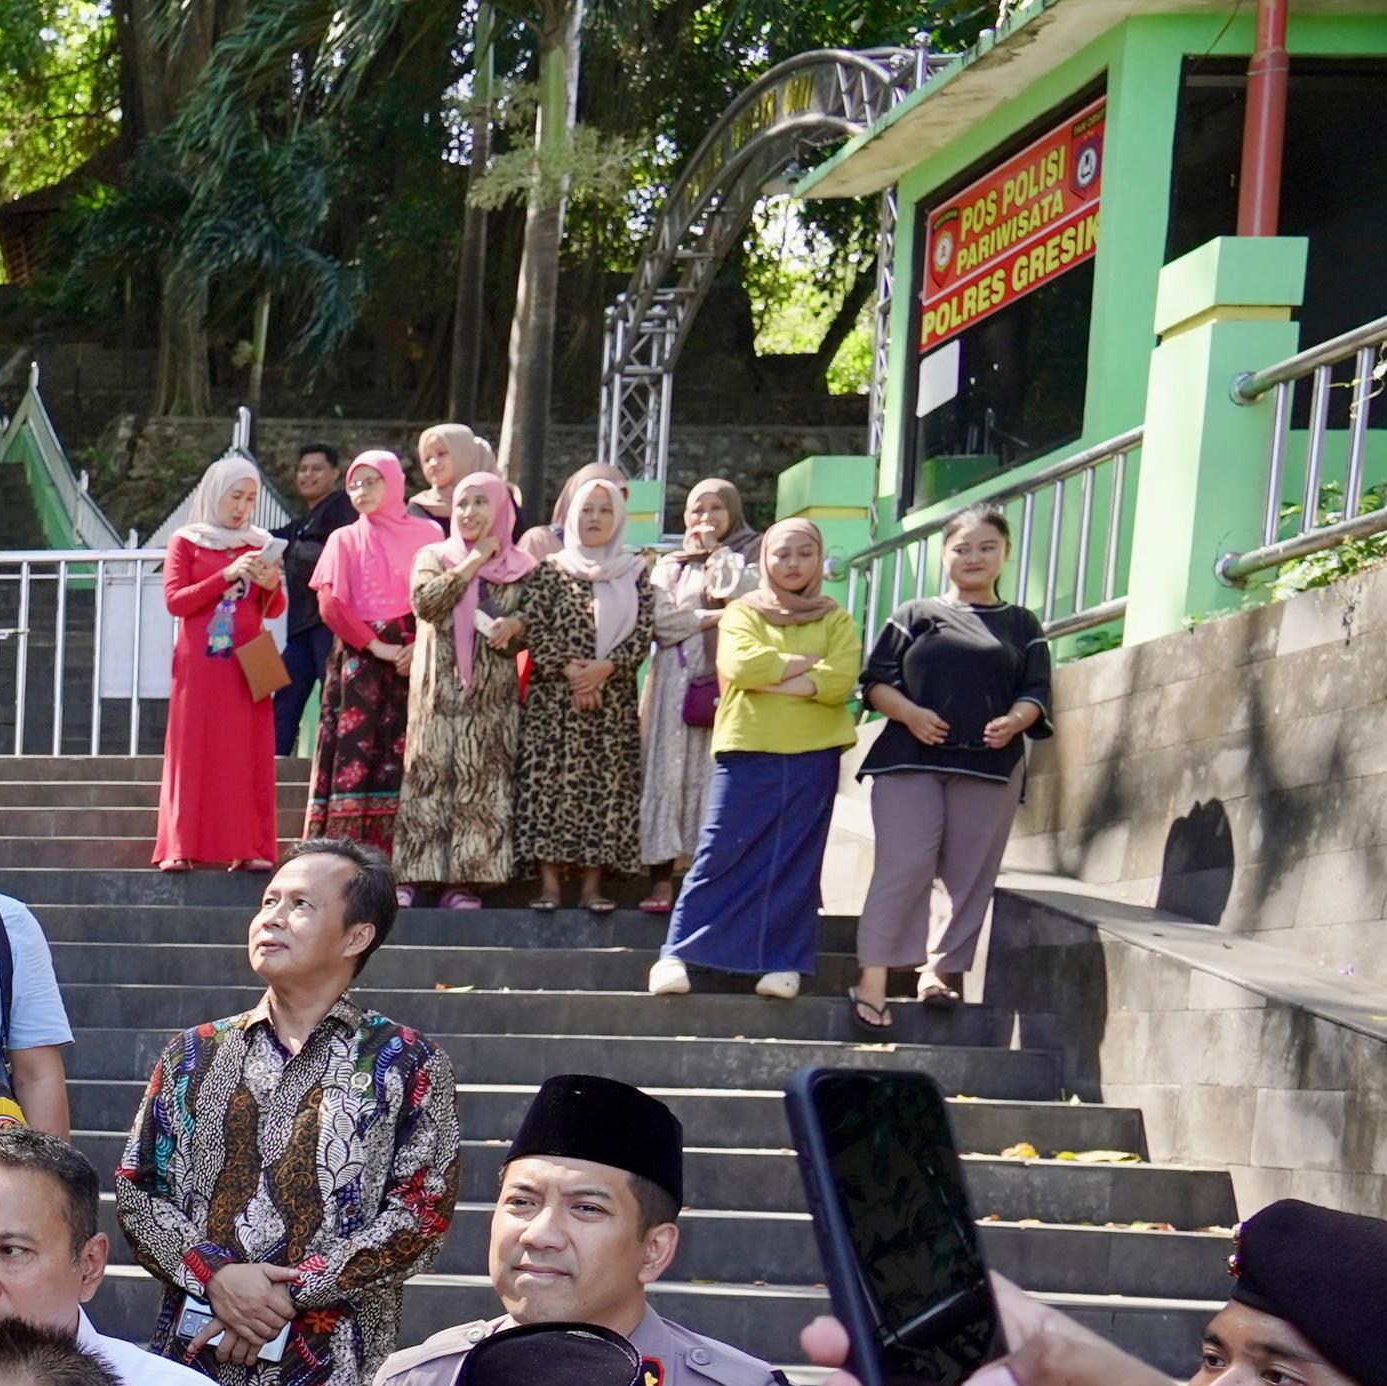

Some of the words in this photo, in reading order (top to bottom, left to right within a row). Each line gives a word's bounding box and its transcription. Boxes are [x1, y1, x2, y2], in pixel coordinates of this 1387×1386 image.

[955, 188, 1065, 276] PARIWISATA
[961, 190, 997, 242] POS
[1002, 145, 1065, 215] POLISI
[920, 268, 1007, 345] POLRES
[1011, 210, 1101, 293] GRESIK
